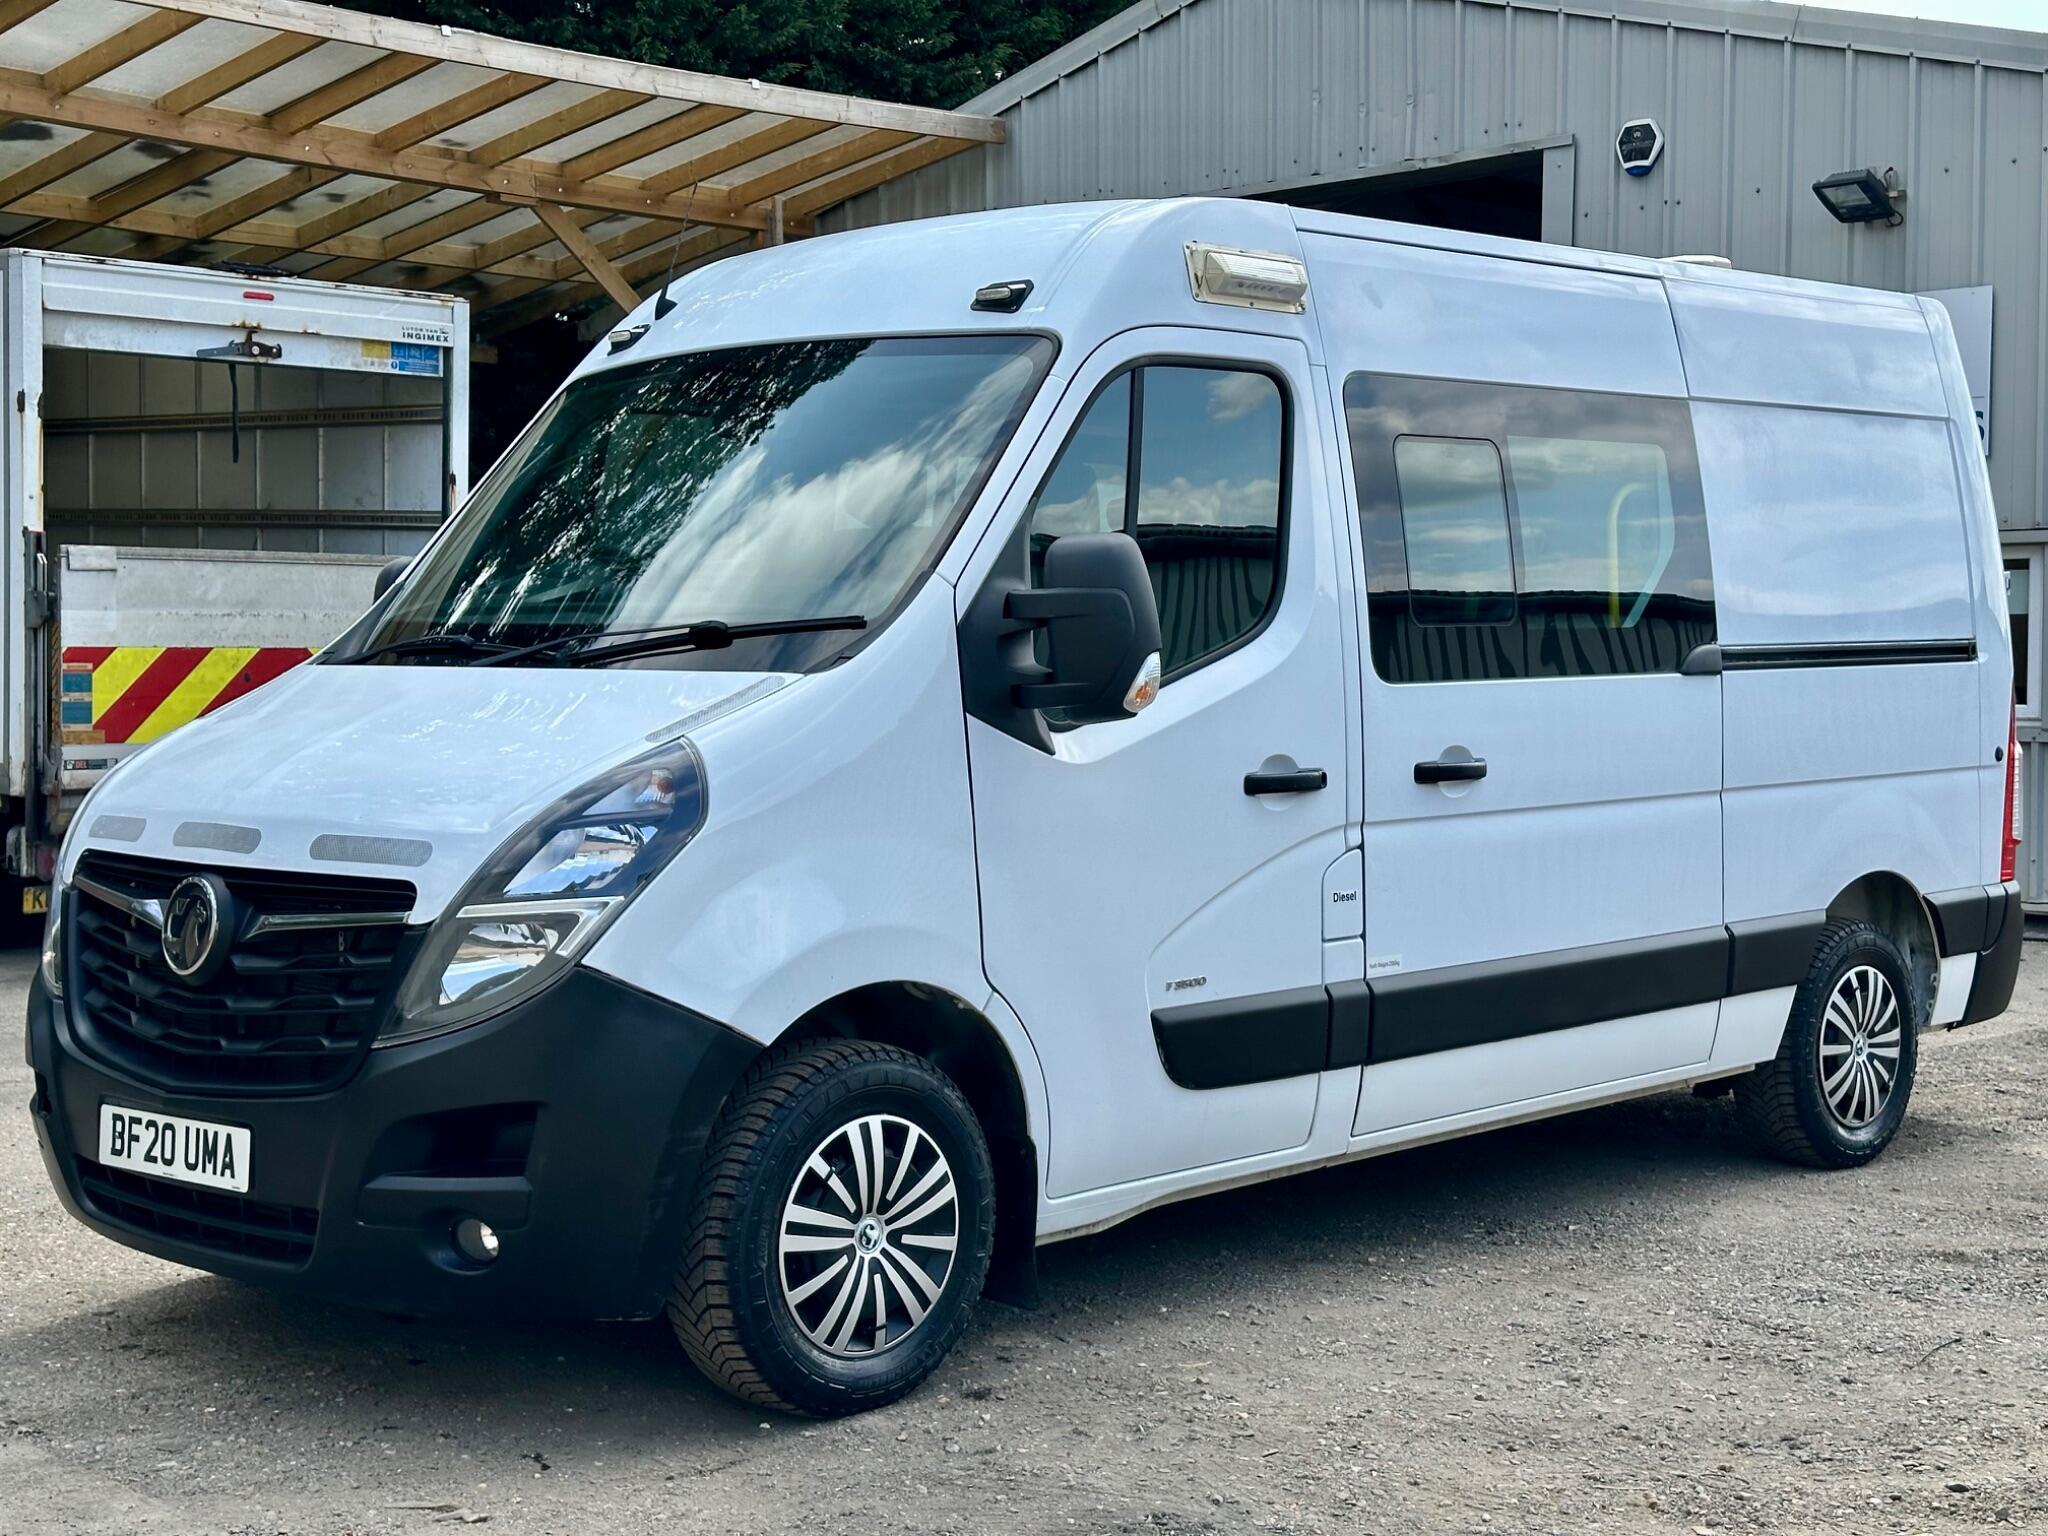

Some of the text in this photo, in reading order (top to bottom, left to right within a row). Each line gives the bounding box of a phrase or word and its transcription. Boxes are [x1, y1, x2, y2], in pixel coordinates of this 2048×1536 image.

[402, 331, 449, 342] INGIMEX
[1333, 890, 1357, 903] Diesel
[110, 1112, 236, 1179] BF20 UMA
